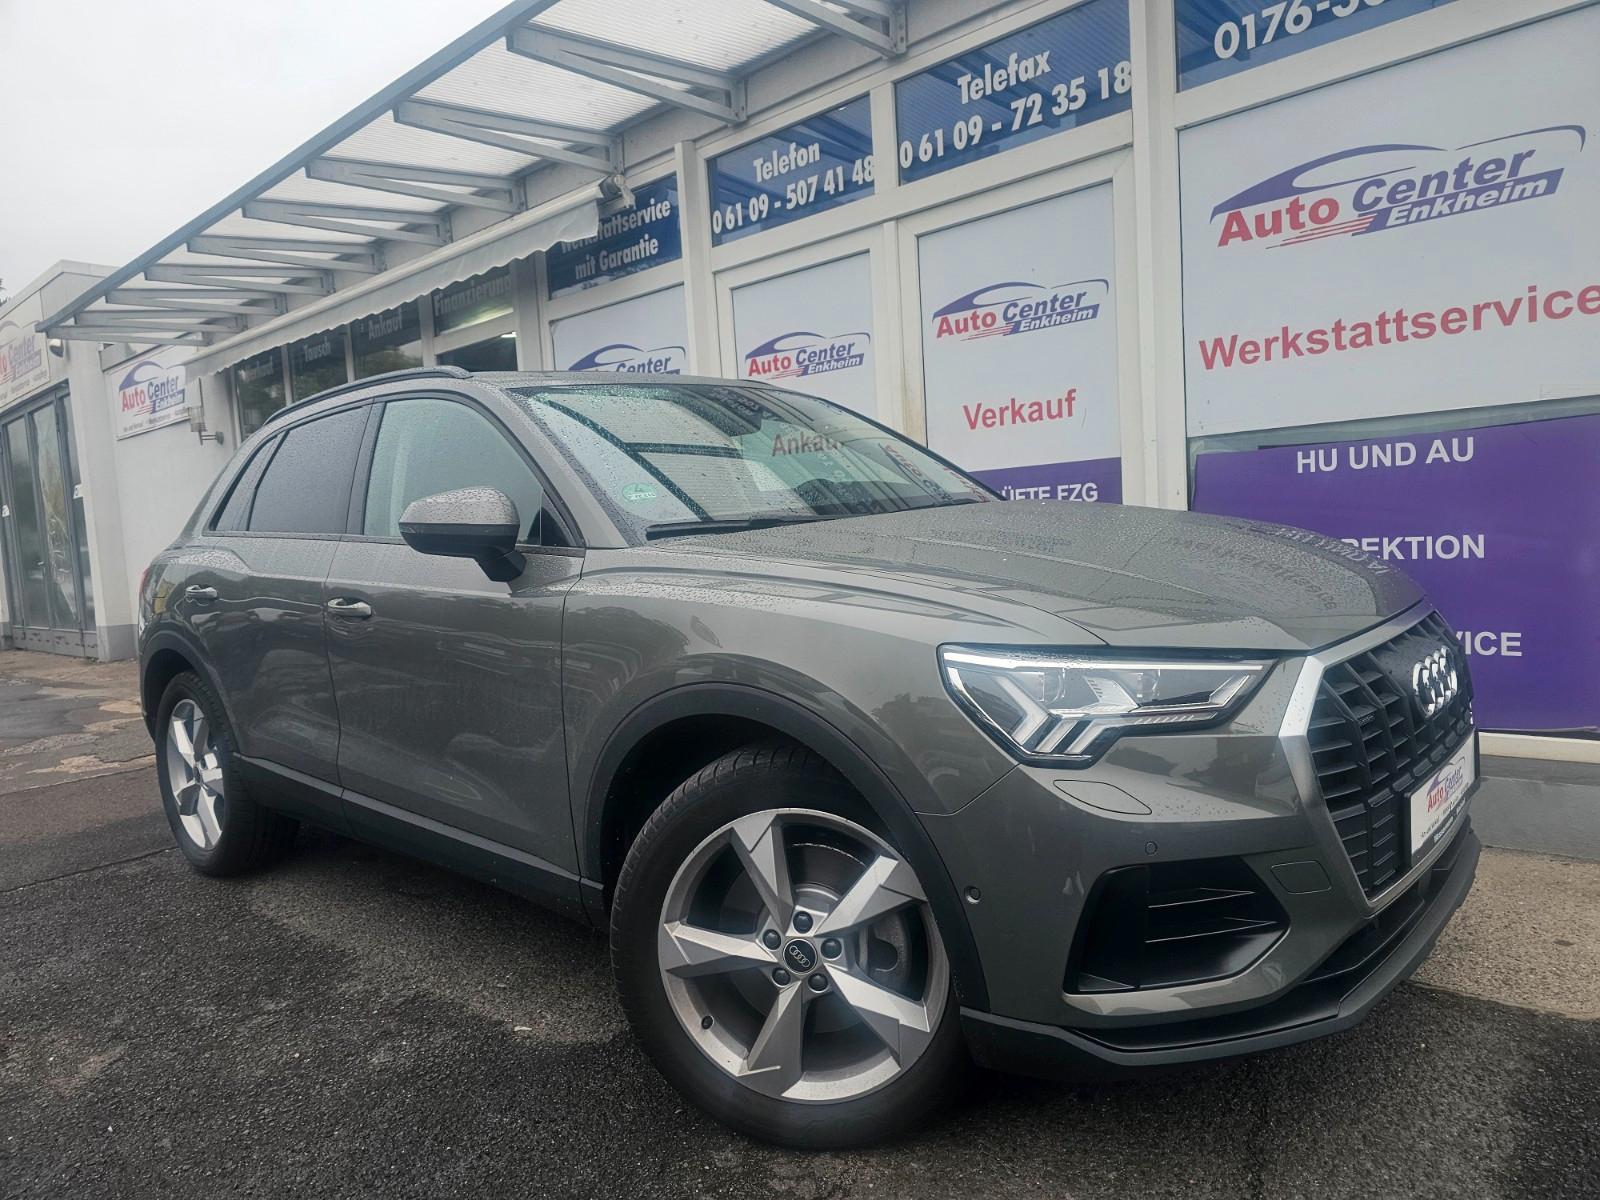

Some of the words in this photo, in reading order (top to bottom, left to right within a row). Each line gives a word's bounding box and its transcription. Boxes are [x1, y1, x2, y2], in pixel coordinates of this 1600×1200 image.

[1214, 0, 1388, 59] 0176-
[957, 50, 1051, 104] Telefax
[900, 140, 913, 169] 0
[918, 128, 944, 162] 61
[953, 114, 983, 150] 09
[1010, 92, 1043, 131] 72
[1051, 75, 1087, 116] 35
[1097, 60, 1131, 100] 18
[753, 142, 820, 183] Telefon
[712, 210, 722, 234] 0
[725, 202, 743, 230] 61
[749, 193, 769, 222] 09
[786, 174, 819, 210] 507
[823, 165, 845, 195] 41
[852, 154, 875, 185] 48
[1218, 196, 1340, 247] Auto
[1352, 149, 1536, 213] Center
[1385, 177, 1547, 227] Enkheim
[561, 198, 671, 254] tattservice
[575, 254, 596, 279] mit
[600, 233, 659, 271] Garantie
[936, 308, 997, 338] Auto
[1002, 291, 1087, 323] Center
[1018, 306, 1094, 332] Enkheim
[1199, 285, 1600, 370] Werkstattservice
[748, 354, 792, 376] Auto
[795, 342, 856, 366] Center
[807, 356, 860, 374] Enkheim
[122, 387, 146, 411] Auto
[148, 376, 178, 400] Center
[963, 388, 1077, 430] Verkauf
[772, 431, 837, 456] Ankau
[1296, 448, 1338, 474] HU
[1349, 442, 1417, 470] UND
[1425, 437, 1475, 464] AU
[1002, 485, 1051, 501] ÜFTE
[1057, 482, 1099, 502] FZG
[1428, 786, 1443, 813] Auto
